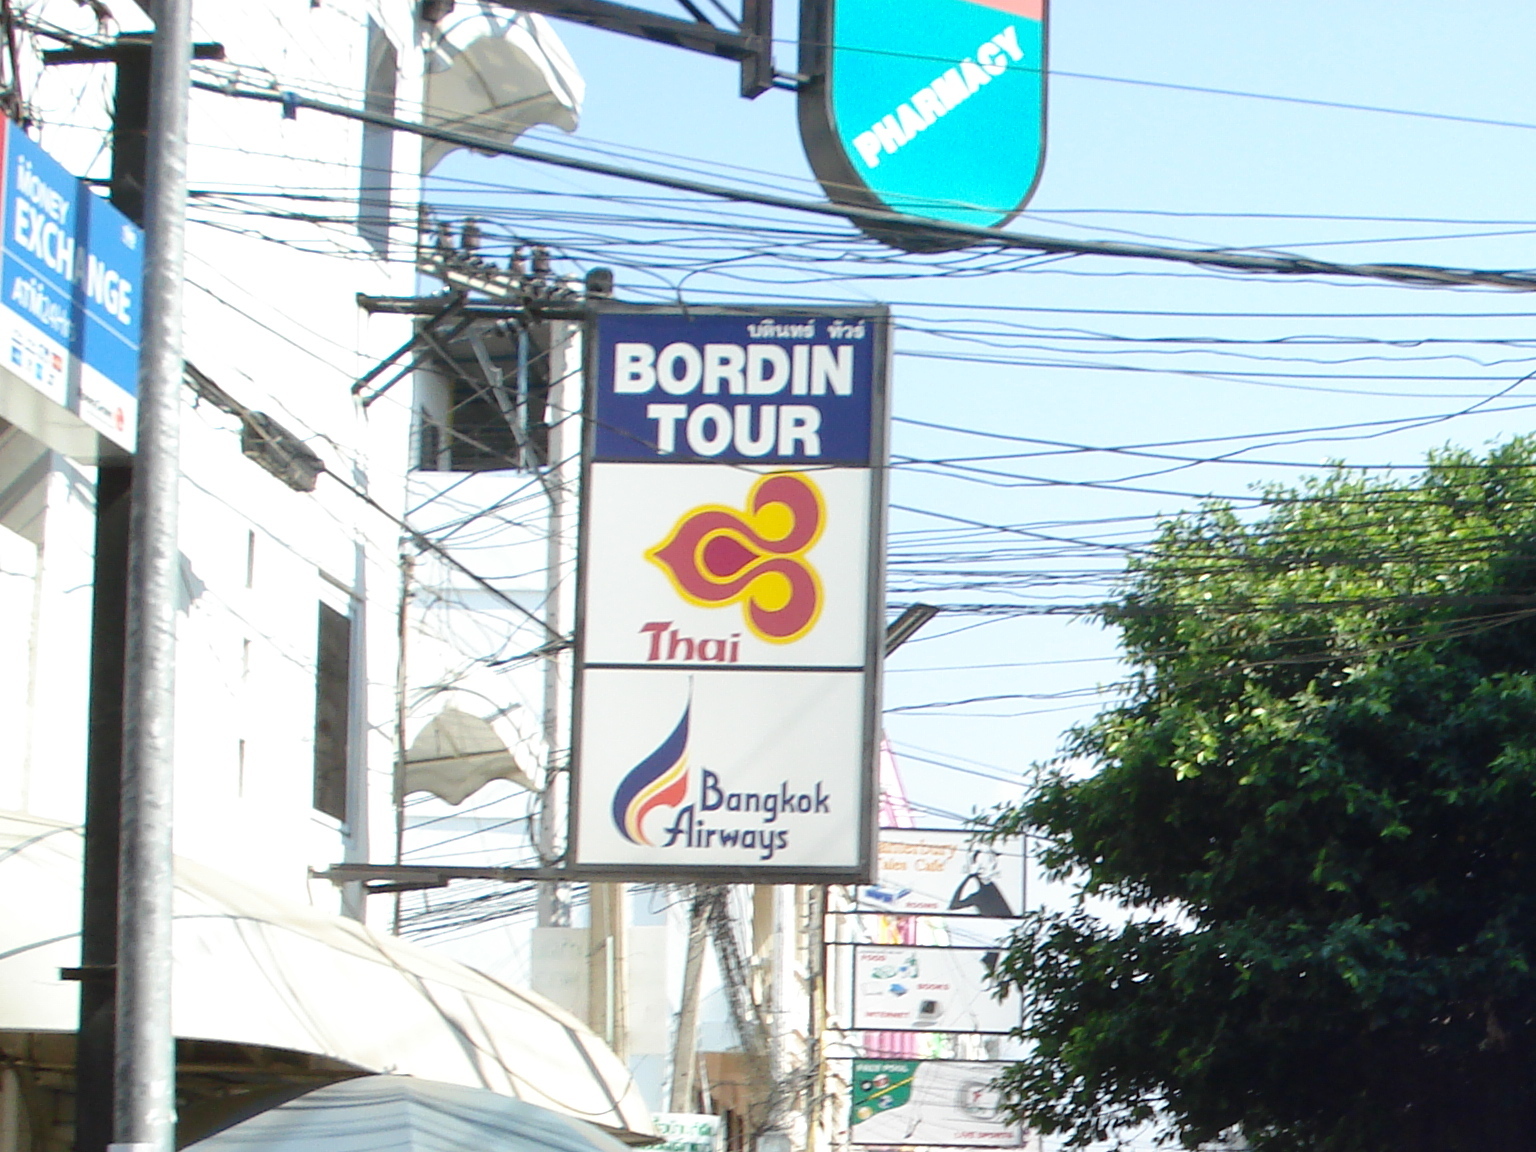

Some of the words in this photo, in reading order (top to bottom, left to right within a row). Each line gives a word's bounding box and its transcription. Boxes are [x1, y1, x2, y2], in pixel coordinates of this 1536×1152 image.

[852, 25, 1024, 169] PHARMACY
[16, 156, 70, 224] MONEY
[14, 197, 132, 325] EXCHANGE
[612, 342, 854, 396] BORDIN
[646, 404, 822, 456] TOUR
[639, 621, 741, 663] Thai
[701, 767, 831, 823] Bangkok
[662, 804, 789, 860] Airways
